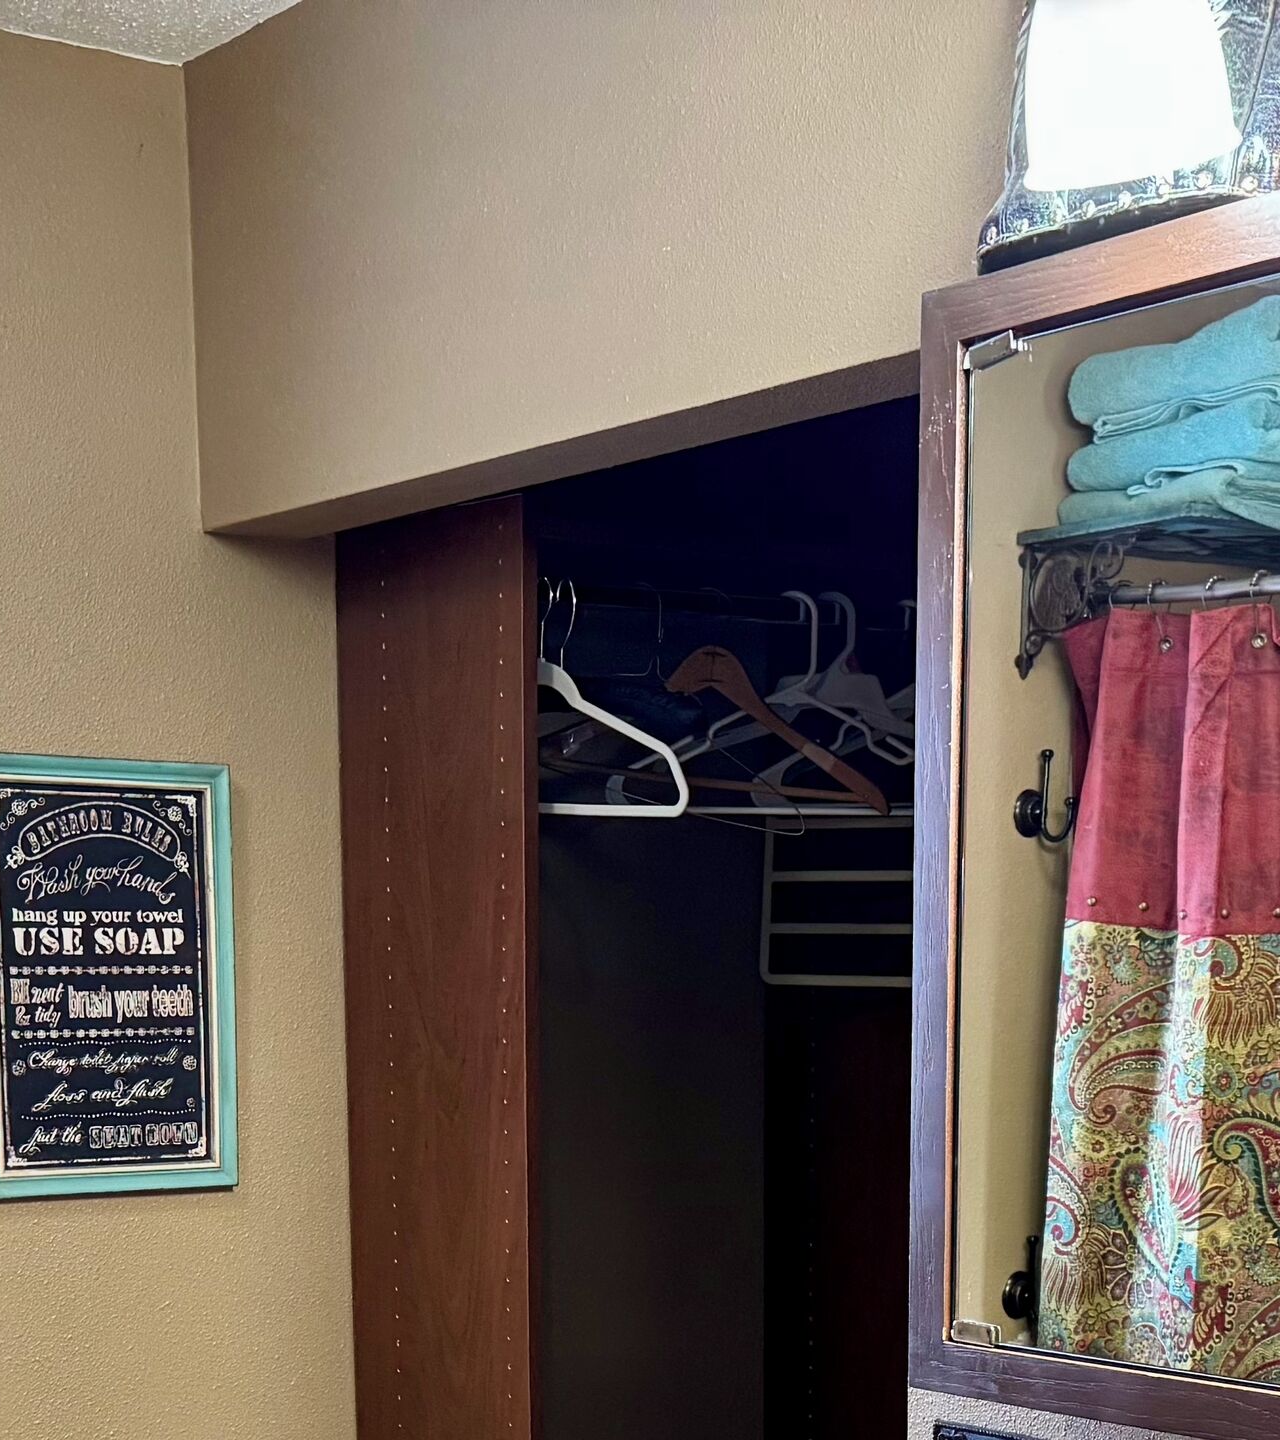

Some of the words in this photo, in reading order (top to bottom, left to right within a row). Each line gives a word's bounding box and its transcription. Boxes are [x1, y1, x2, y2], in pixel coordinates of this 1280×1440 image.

[26, 808, 113, 854] BATHROOM
[121, 811, 173, 853] RULES
[17, 854, 83, 904] Wash
[81, 864, 120, 896] your
[117, 855, 178, 905] hands
[11, 907, 58, 925] hang
[63, 910, 87, 925] up
[90, 910, 131, 926] your
[136, 908, 184, 924] towel
[12, 927, 84, 956] USE
[94, 927, 185, 956] SOAP
[30, 982, 64, 1005] neat
[67, 984, 113, 1019] brush
[114, 989, 150, 1023] your
[151, 984, 194, 1018] teeth
[34, 1005, 62, 1028] tidy
[31, 1080, 88, 1112] floss
[91, 1078, 126, 1101] and
[116, 1077, 174, 1107] flush
[19, 1125, 60, 1155] put
[60, 1121, 84, 1146] the
[89, 1125, 143, 1149] SEAT
[145, 1122, 199, 1146] DOWN
